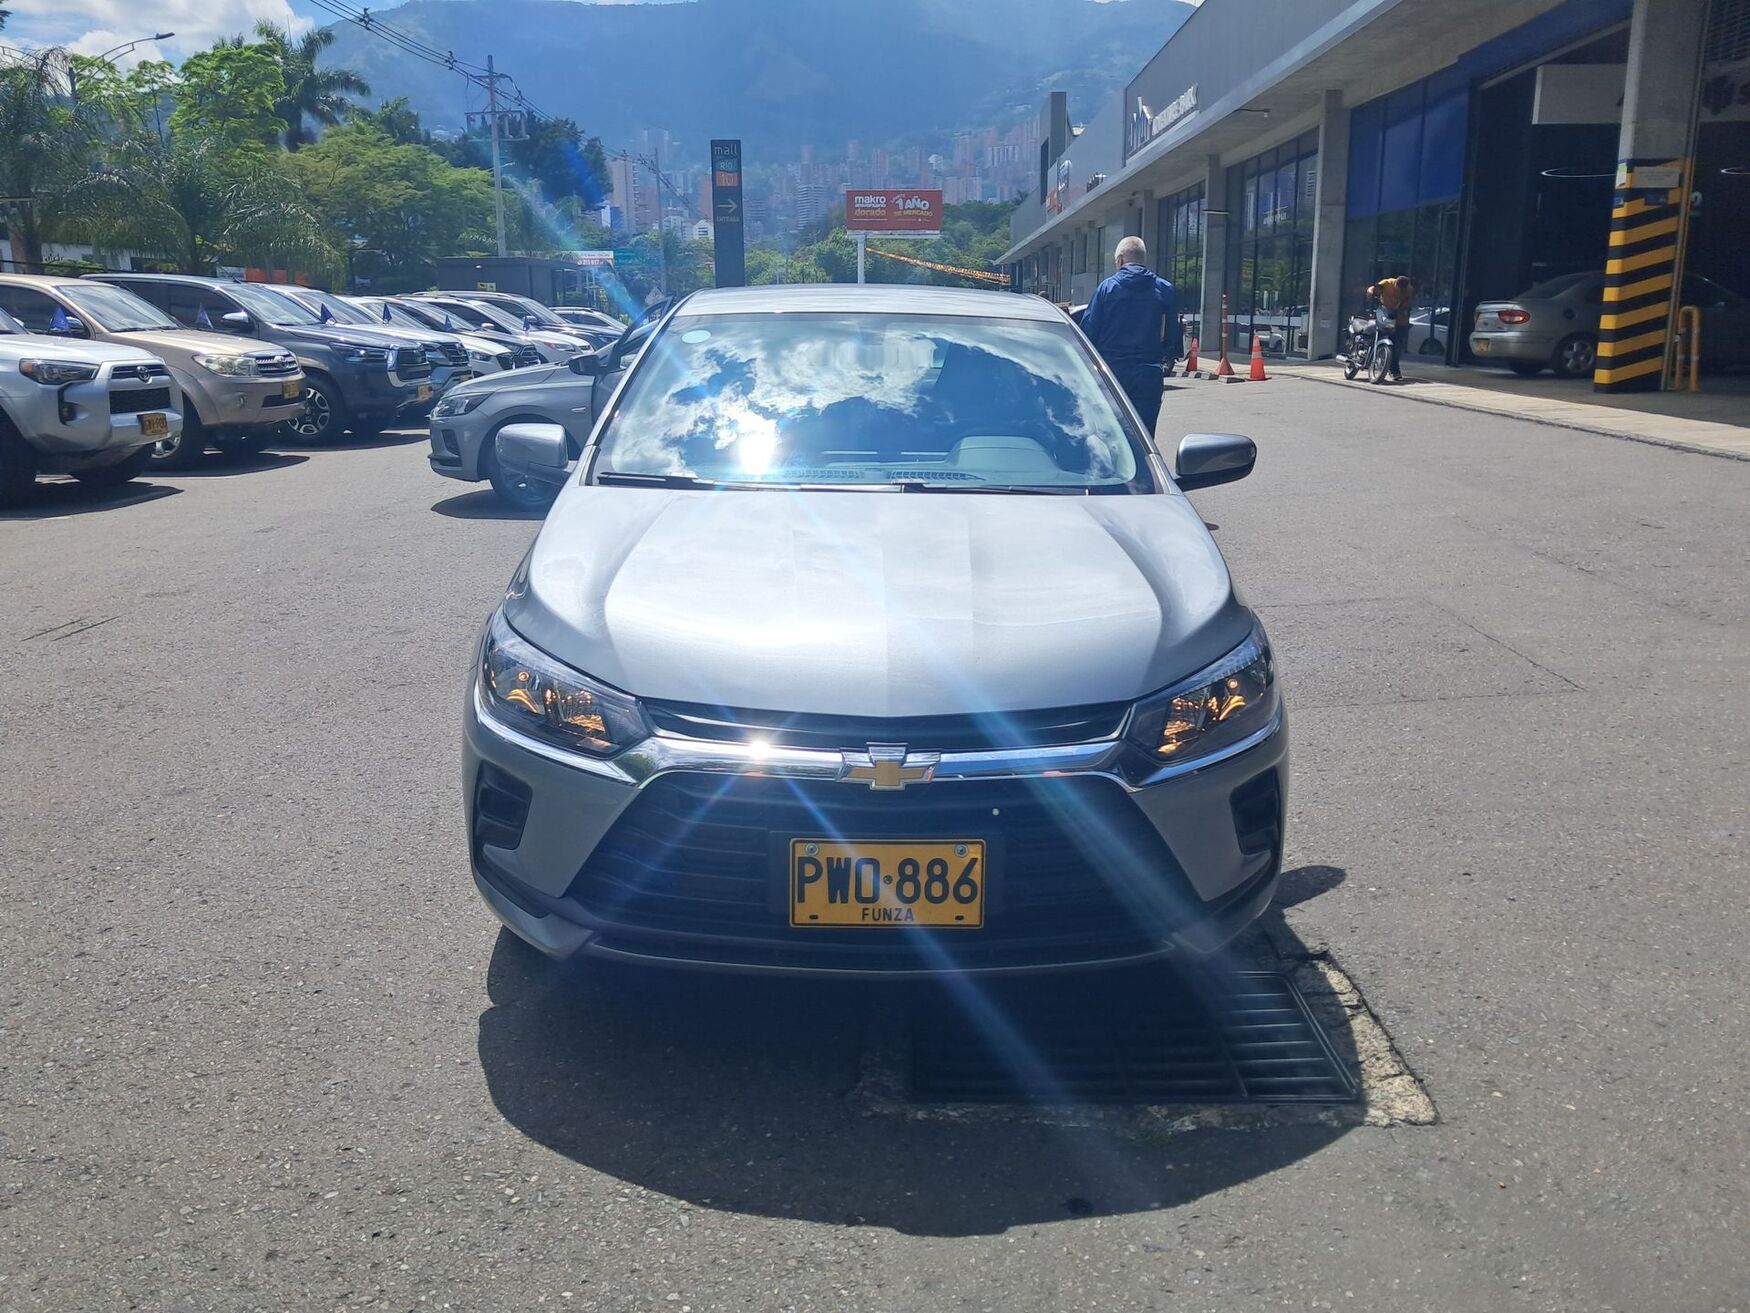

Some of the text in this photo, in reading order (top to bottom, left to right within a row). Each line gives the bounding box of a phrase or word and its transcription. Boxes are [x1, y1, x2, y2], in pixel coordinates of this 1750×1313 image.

[714, 143, 737, 155] mall
[721, 172, 734, 185] 10
[854, 194, 887, 204] makro
[895, 198, 904, 210] 1
[905, 195, 930, 211] AÑO
[854, 207, 887, 217] dorado
[903, 209, 934, 217] MERCADO
[861, 907, 915, 922] FUNZA
